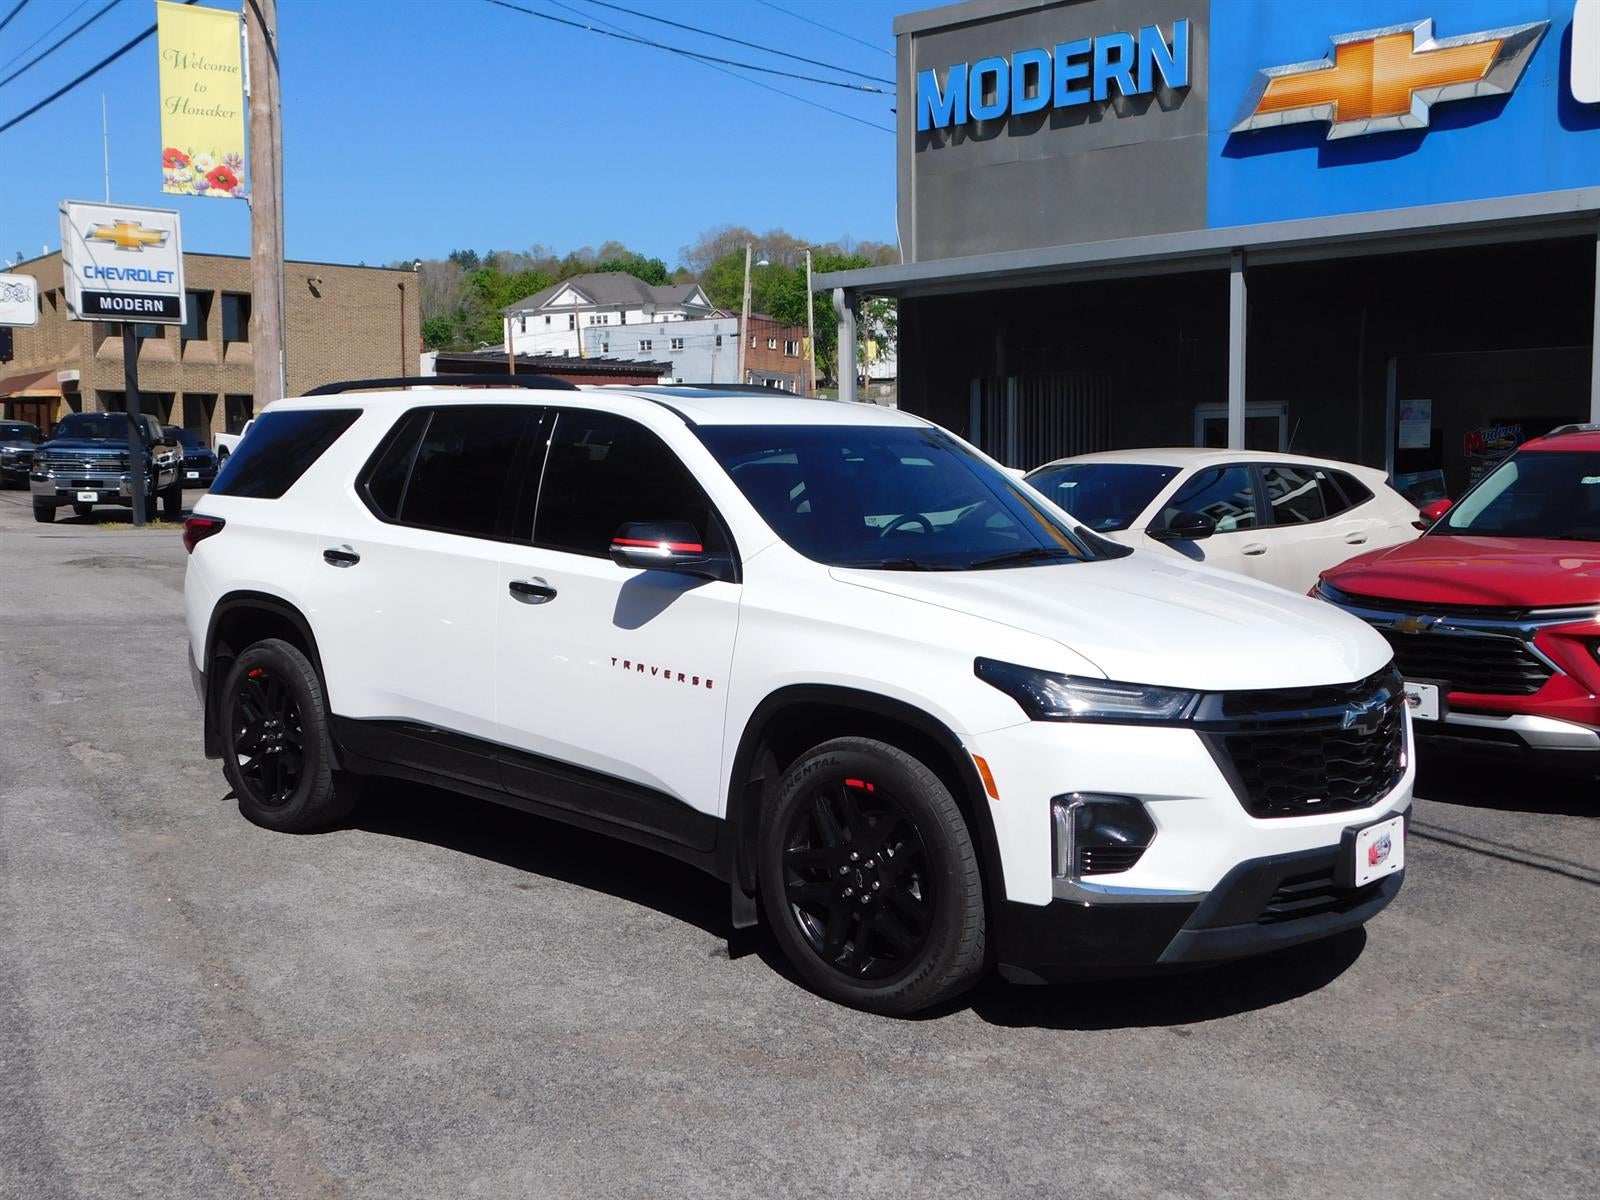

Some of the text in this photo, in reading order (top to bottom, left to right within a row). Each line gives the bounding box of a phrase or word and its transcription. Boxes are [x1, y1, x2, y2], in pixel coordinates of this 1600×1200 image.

[162, 49, 239, 74] Welcome
[194, 80, 207, 93] to
[916, 18, 1191, 132] MODERN
[164, 96, 237, 119] Honaker
[83, 265, 174, 284] CHEVROLET
[99, 297, 164, 313] MODERN
[611, 657, 713, 689] TRAVERSE
